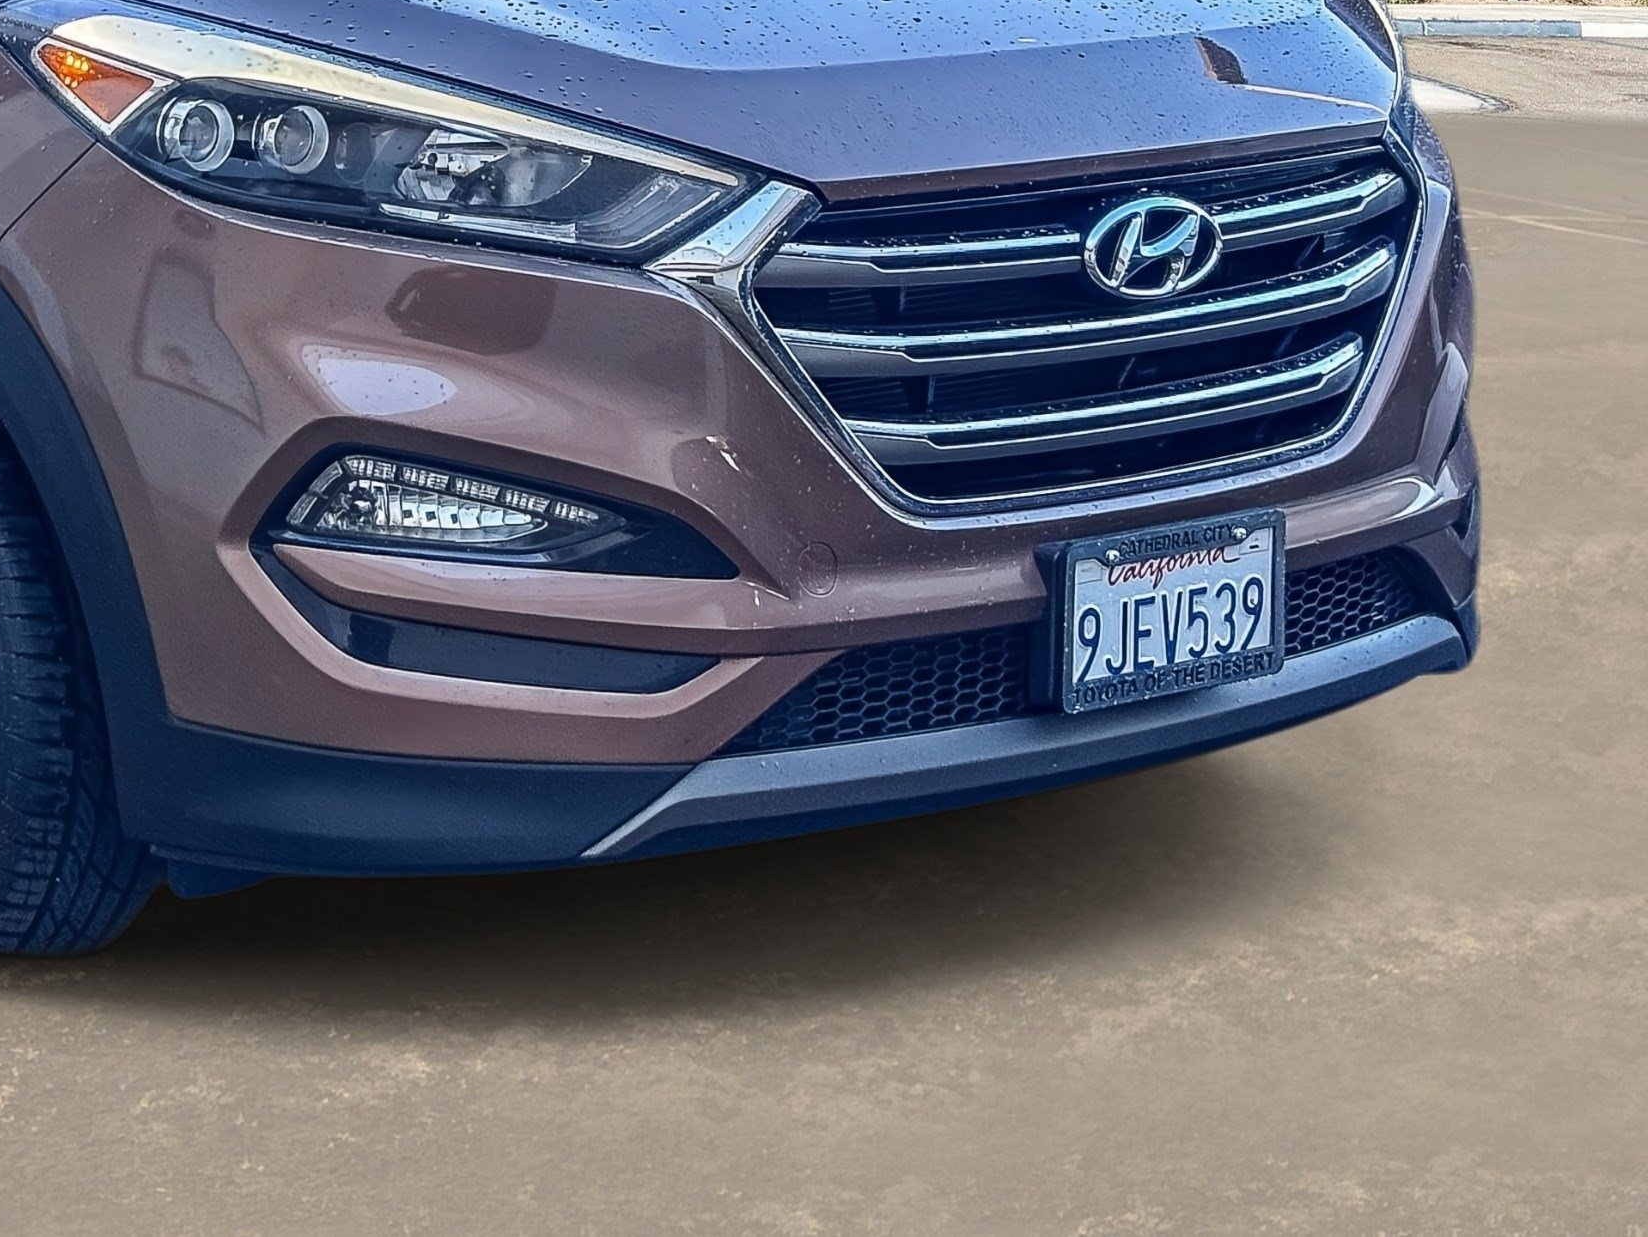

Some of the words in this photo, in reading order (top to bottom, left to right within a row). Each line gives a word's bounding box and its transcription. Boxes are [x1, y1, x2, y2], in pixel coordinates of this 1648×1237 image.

[1119, 532, 1198, 557] CATHEDRAL
[1204, 525, 1235, 543] CITY
[1108, 546, 1241, 590] California
[1077, 577, 1264, 682] 9JEV539
[1072, 678, 1138, 704] TOYOTA
[1144, 669, 1167, 692] OF
[1170, 662, 1203, 686] THE
[1209, 651, 1275, 679] DESERT
